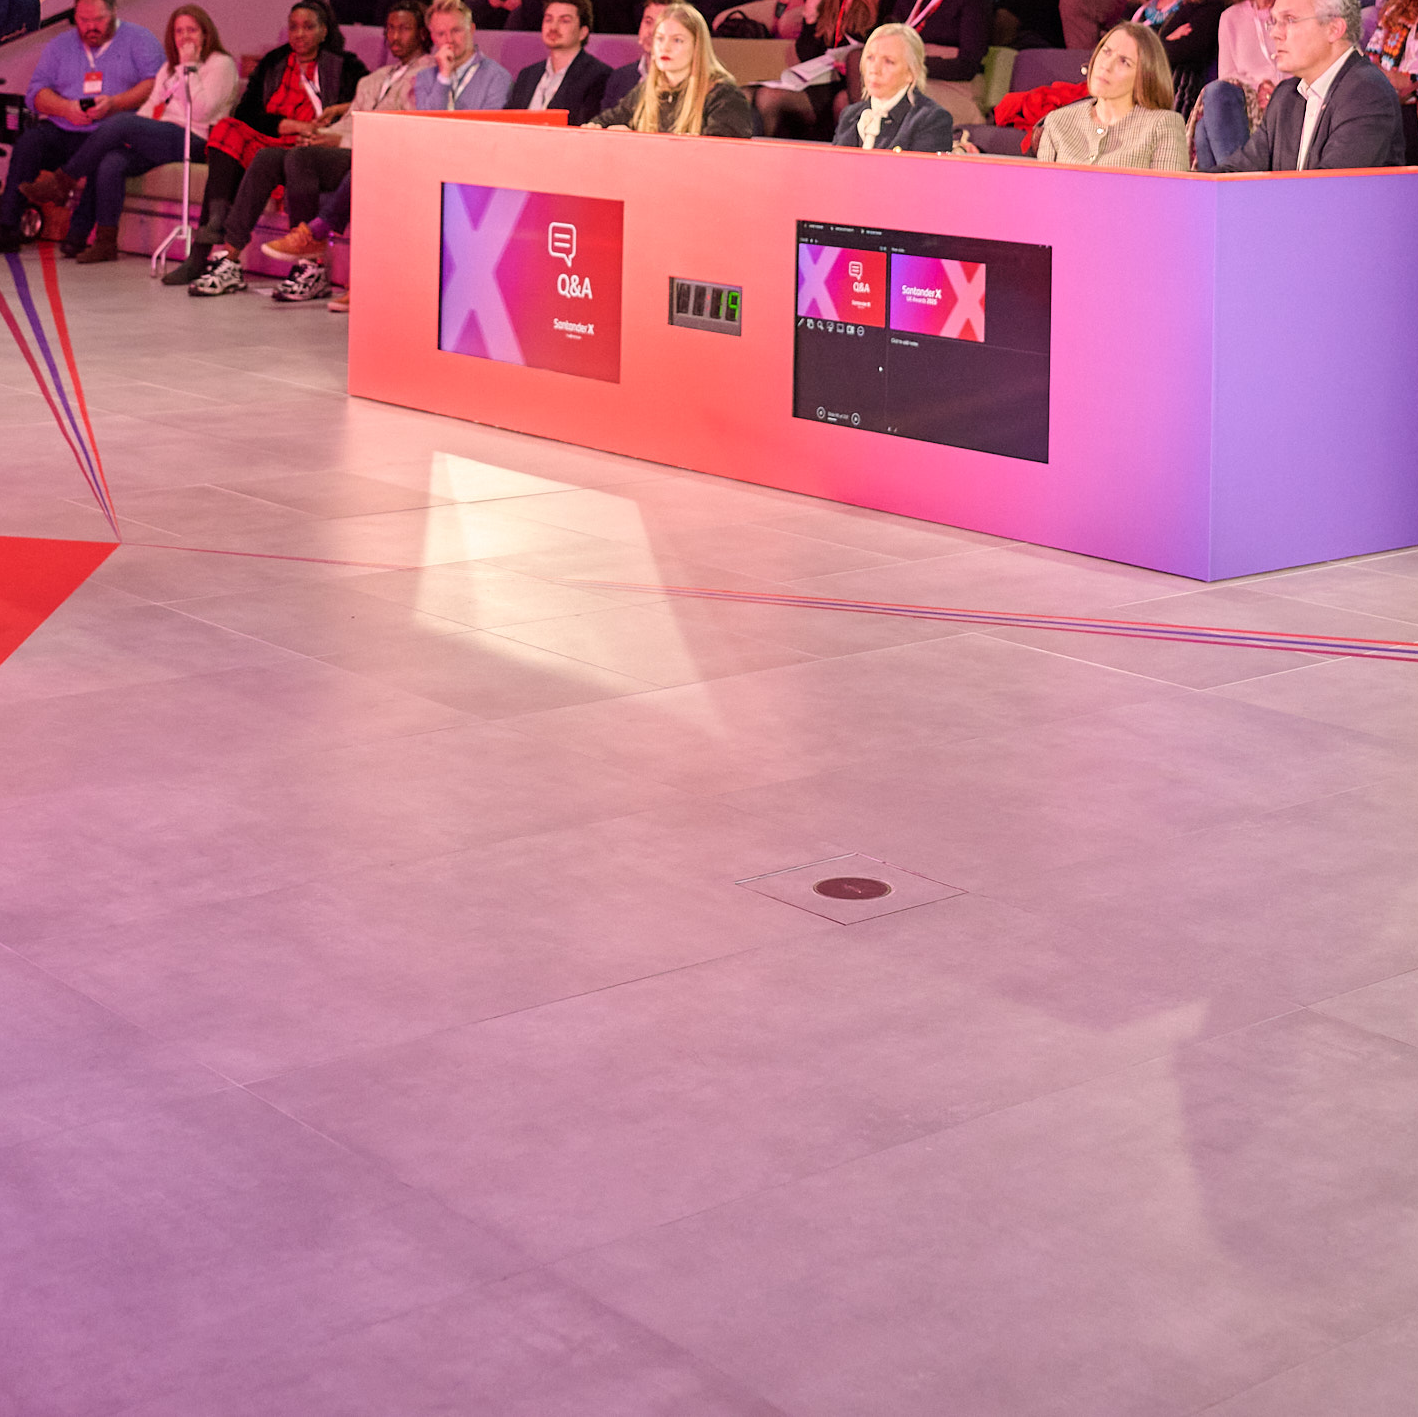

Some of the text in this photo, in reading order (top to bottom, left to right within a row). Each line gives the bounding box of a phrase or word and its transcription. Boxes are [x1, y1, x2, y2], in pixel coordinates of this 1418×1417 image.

[557, 274, 593, 299] Q&A
[853, 282, 870, 293] Q&A
[901, 285, 942, 299] Santander X
[587, 323, 594, 336] X
